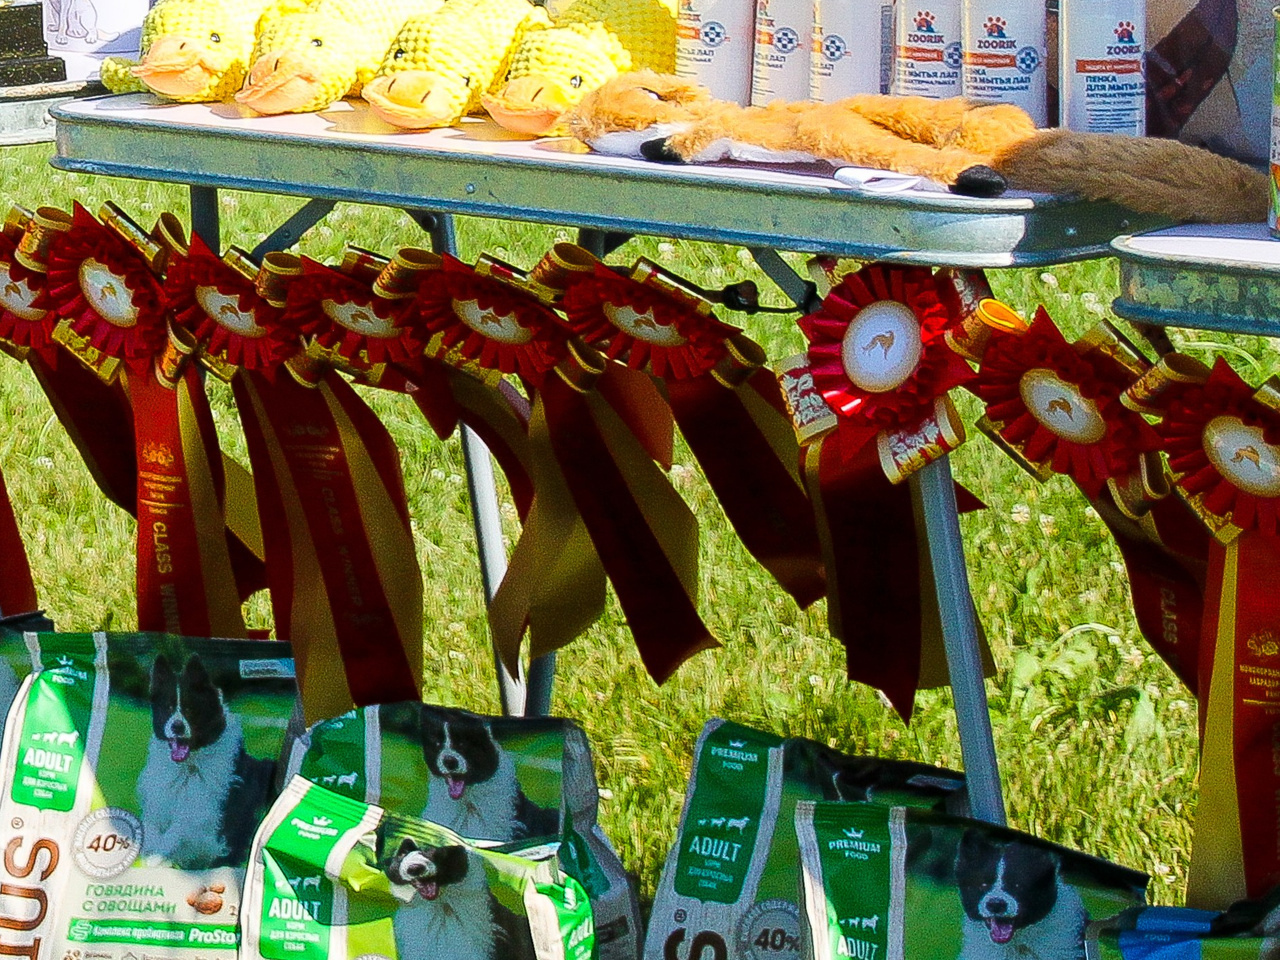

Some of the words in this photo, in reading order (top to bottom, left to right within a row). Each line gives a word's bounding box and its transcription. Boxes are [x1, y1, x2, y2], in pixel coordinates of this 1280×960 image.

[977, 40, 1017, 49] ZOORIK
[152, 522, 173, 574] CLASS
[22, 747, 74, 774] ADULT
[711, 746, 759, 763] PREMIUM
[86, 833, 131, 853] 40%
[689, 835, 742, 863] ADULT
[828, 839, 882, 854] PREMIUM
[844, 851, 870, 861] FOOD
[85, 883, 165, 898] ГОВЯДИНА
[81, 899, 95, 912] С
[97, 899, 177, 915] ОВОЩАМИ
[268, 897, 322, 922] ADULT
[754, 927, 800, 952] 40%
[836, 934, 879, 960] ADULT
